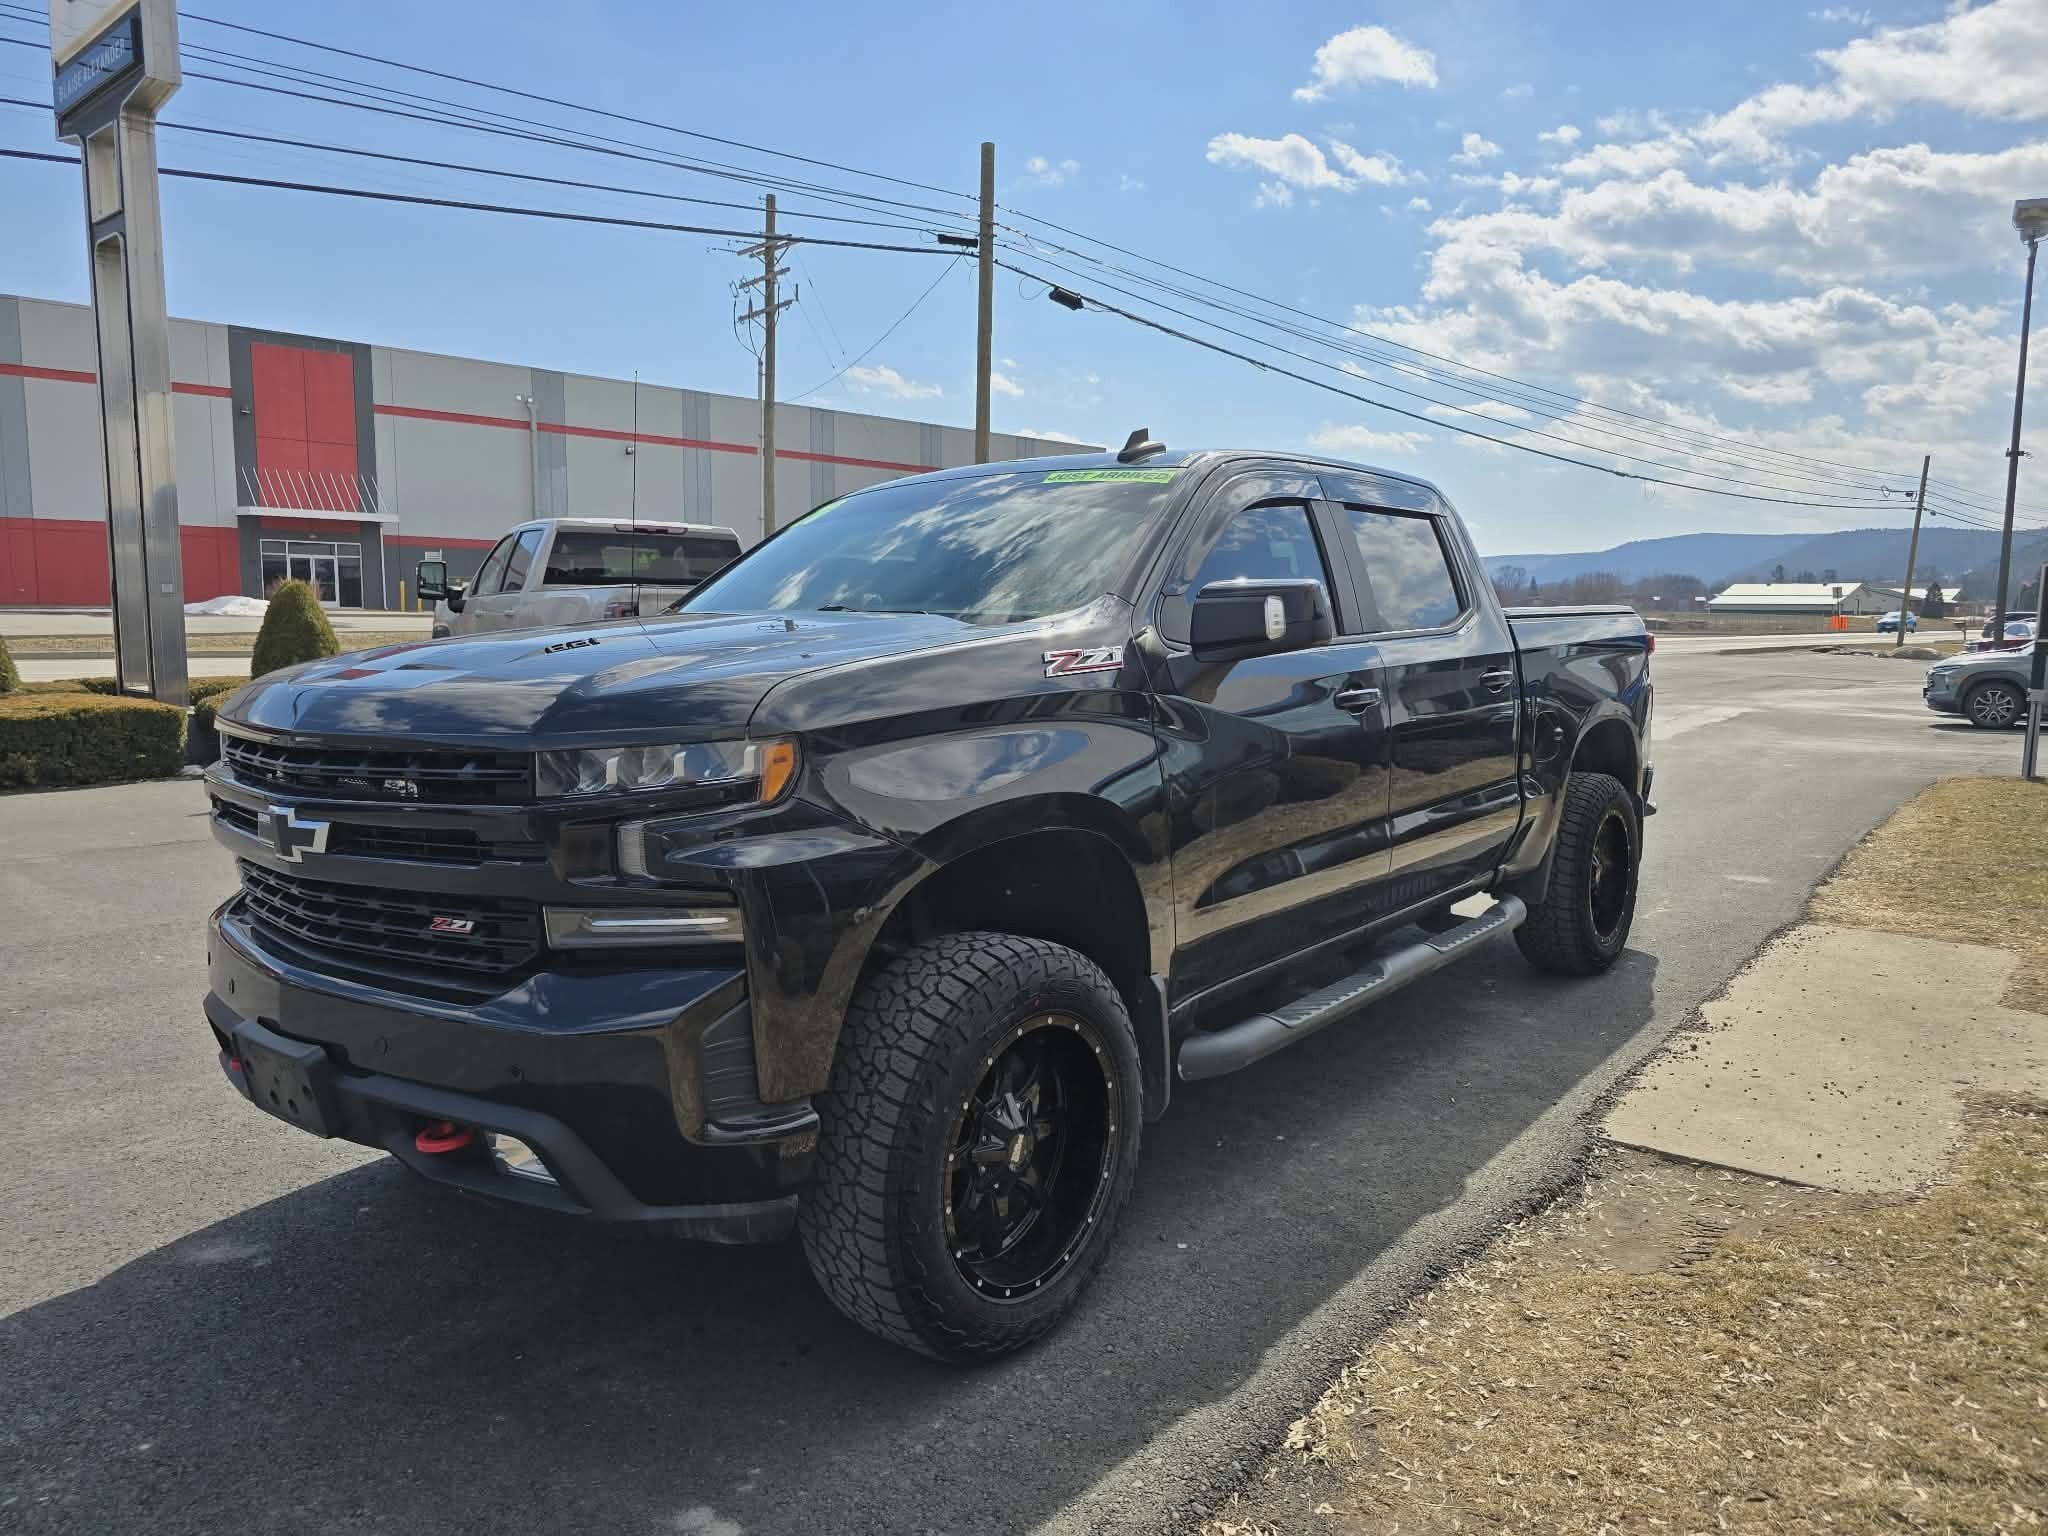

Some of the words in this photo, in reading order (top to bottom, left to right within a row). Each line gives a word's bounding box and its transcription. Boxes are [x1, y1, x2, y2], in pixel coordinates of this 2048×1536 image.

[83, 39, 125, 81] ALEXANDER
[1047, 471, 1092, 481] JUST
[1092, 471, 1170, 481] ARRIVED
[1041, 646, 1124, 678] Z71
[431, 917, 476, 934] Z71
